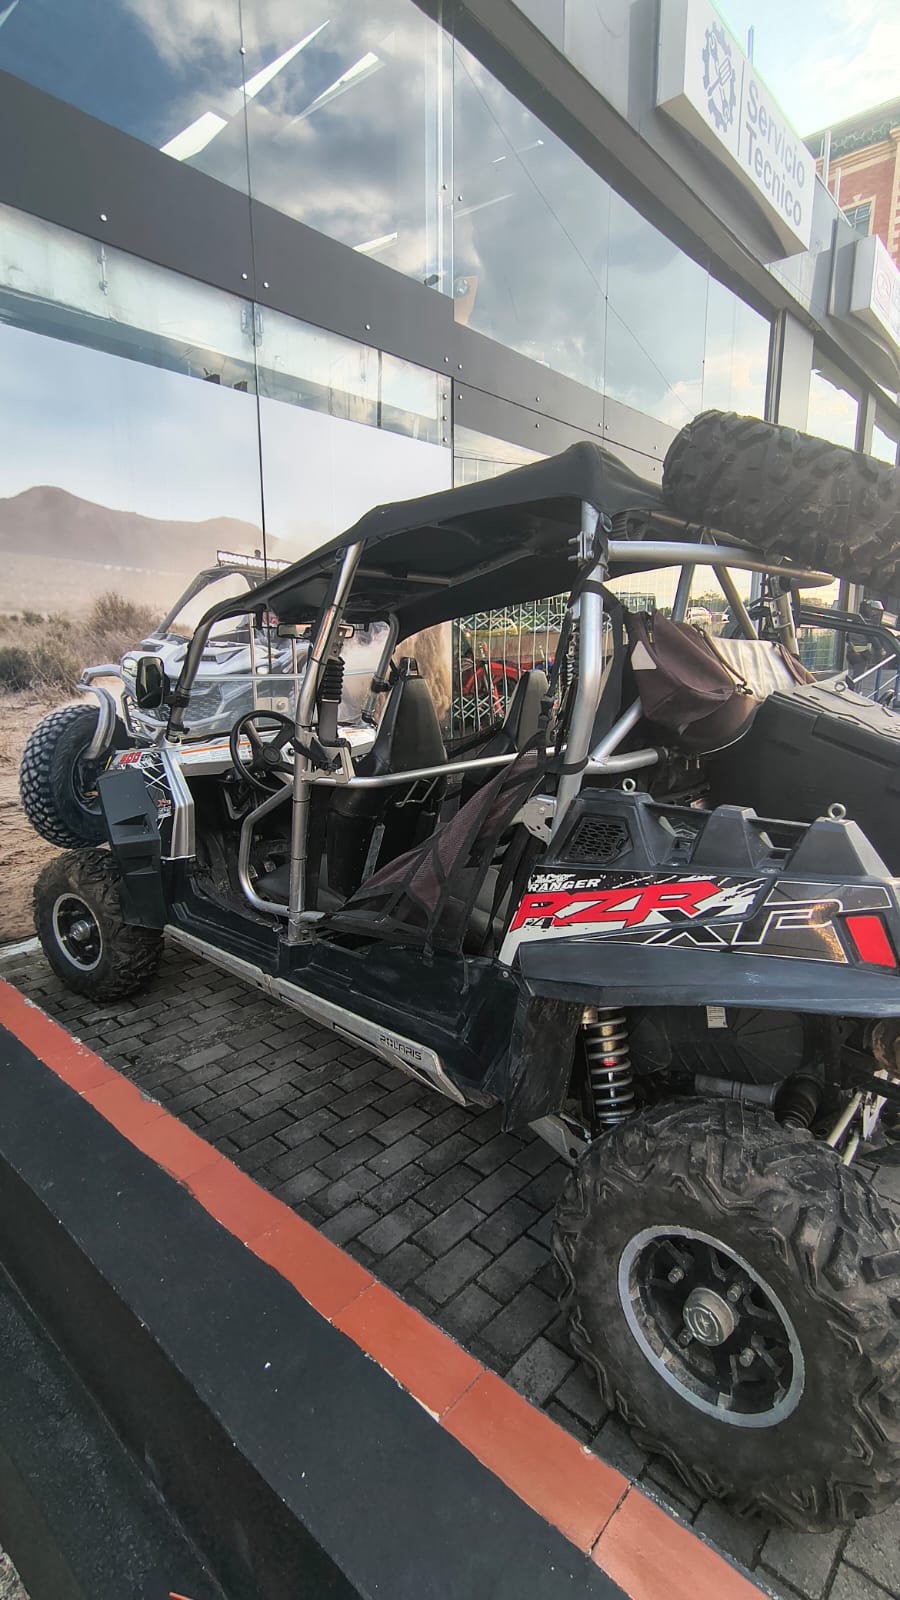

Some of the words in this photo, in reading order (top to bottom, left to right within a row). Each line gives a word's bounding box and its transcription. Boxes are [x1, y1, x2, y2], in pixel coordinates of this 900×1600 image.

[747, 79, 805, 188] Servicio
[745, 122, 802, 227] Tecnico
[509, 881, 723, 932] RZR
[528, 878, 602, 892] RANGER
[379, 1034, 422, 1061] POLARIS
